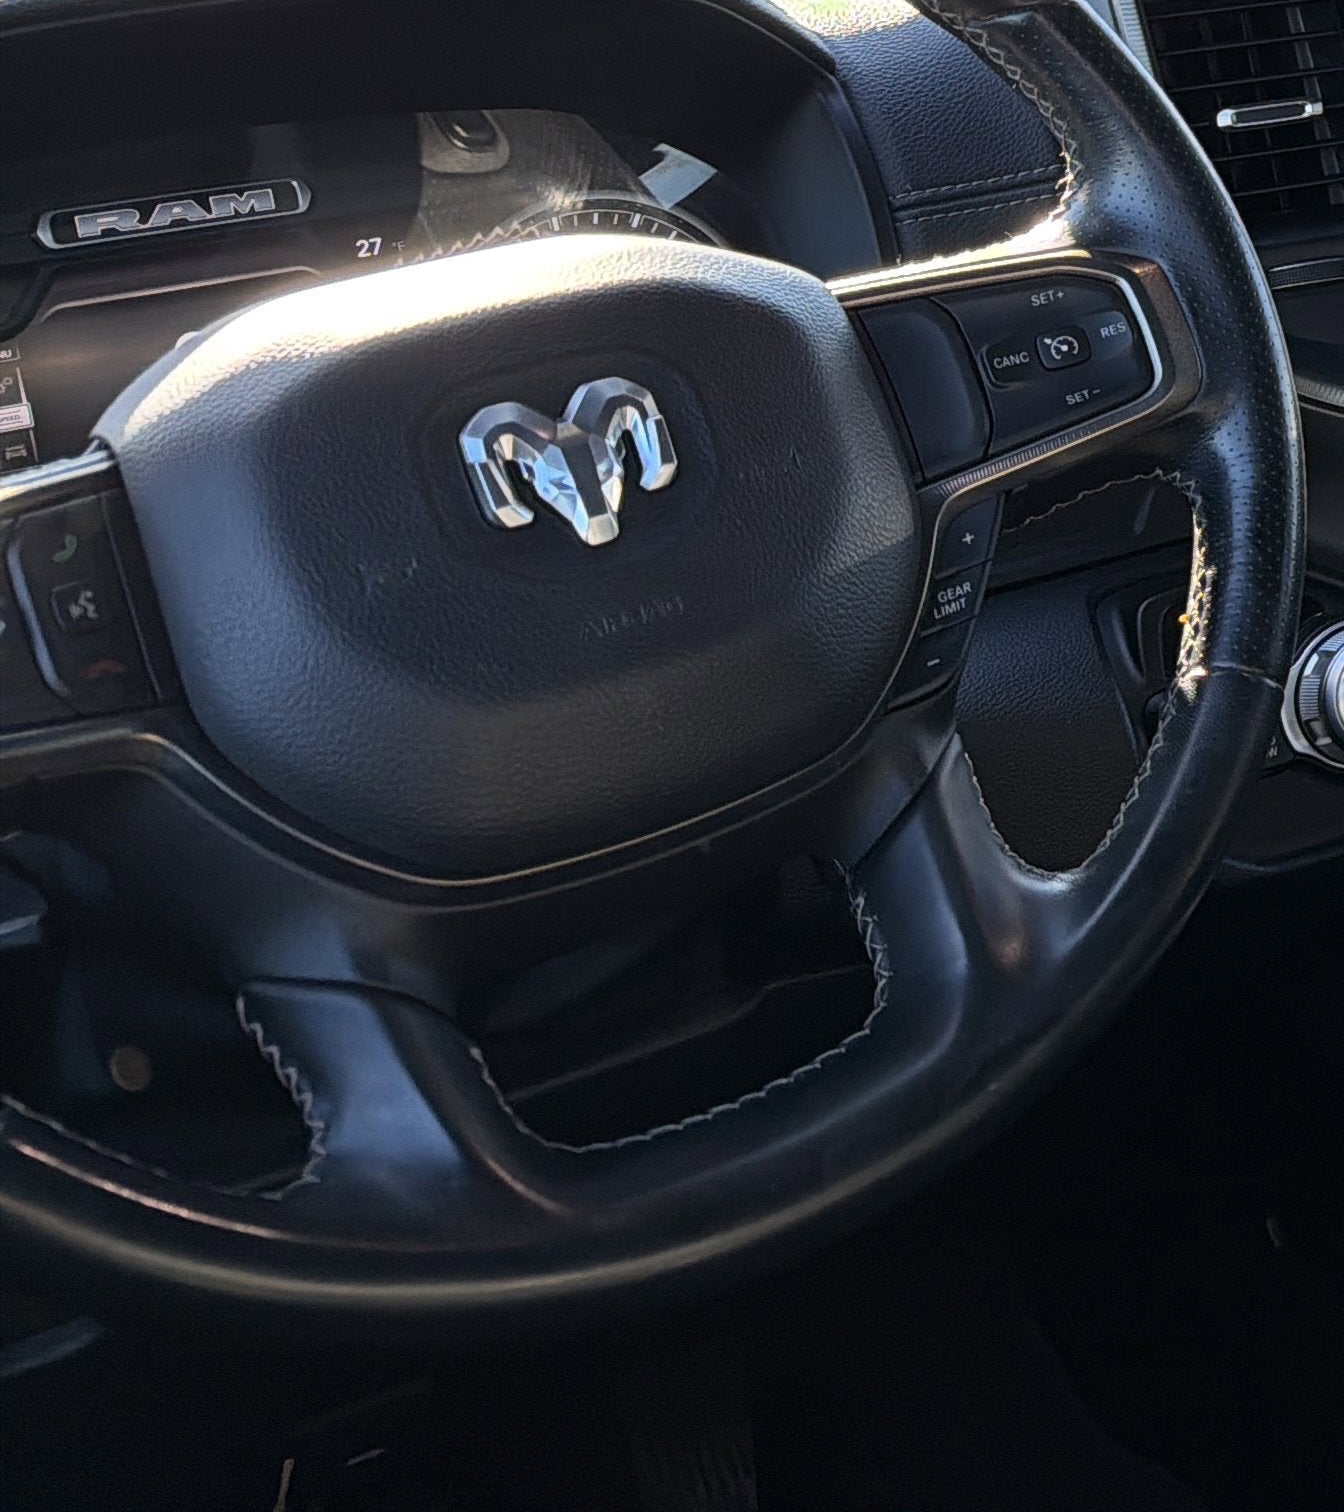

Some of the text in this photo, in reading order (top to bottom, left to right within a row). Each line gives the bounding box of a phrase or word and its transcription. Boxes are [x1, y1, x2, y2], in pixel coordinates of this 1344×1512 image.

[75, 187, 274, 239] RAM
[354, 237, 383, 258] 27
[1100, 321, 1128, 339] RES
[993, 351, 1031, 370] CANC
[937, 581, 973, 604] GEAR
[932, 597, 968, 620] LIMIT
